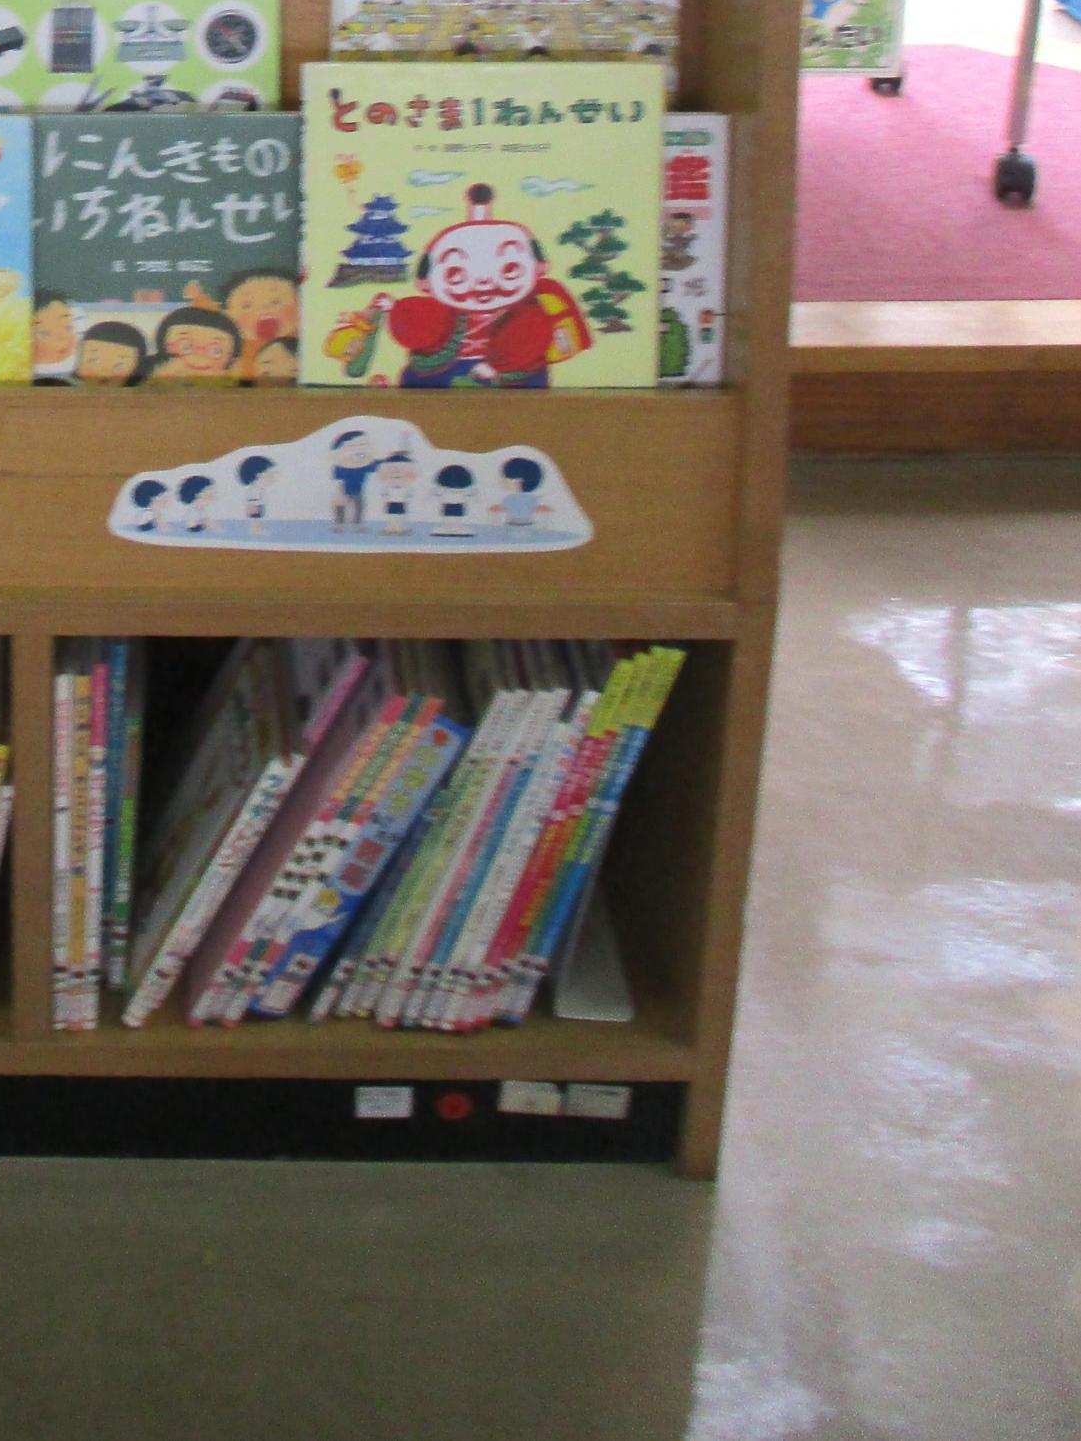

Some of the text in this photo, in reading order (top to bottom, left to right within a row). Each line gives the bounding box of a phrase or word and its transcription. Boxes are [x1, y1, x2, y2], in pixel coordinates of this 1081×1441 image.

[329, 86, 645, 132] とのさま1ねんせい
